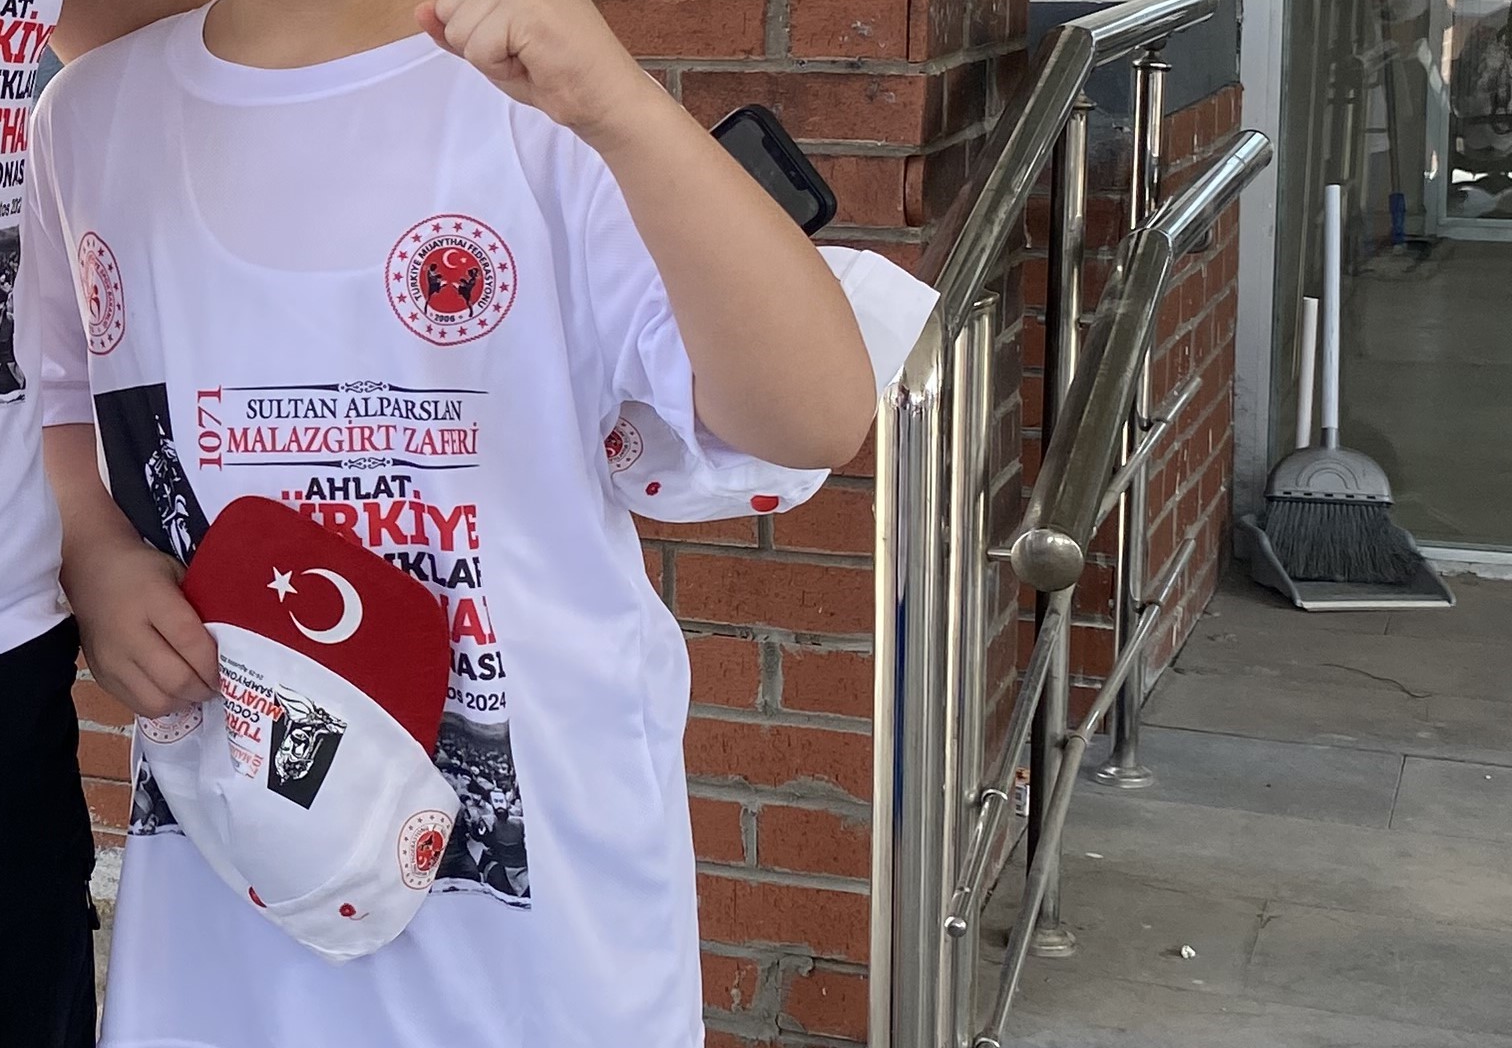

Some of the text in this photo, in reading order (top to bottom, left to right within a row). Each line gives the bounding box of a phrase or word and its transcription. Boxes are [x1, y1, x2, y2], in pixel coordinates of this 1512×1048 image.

[418, 237, 467, 260] MUAYTHAI
[467, 243, 493, 310] FEDERASYONU
[246, 396, 463, 422] SULTAN ALPARSLAN
[197, 385, 223, 472] 1071
[226, 419, 480, 456] MALAZGİRT ZAFERİ
[305, 475, 412, 501] AHLAT
[465, 692, 506, 712] 2024
